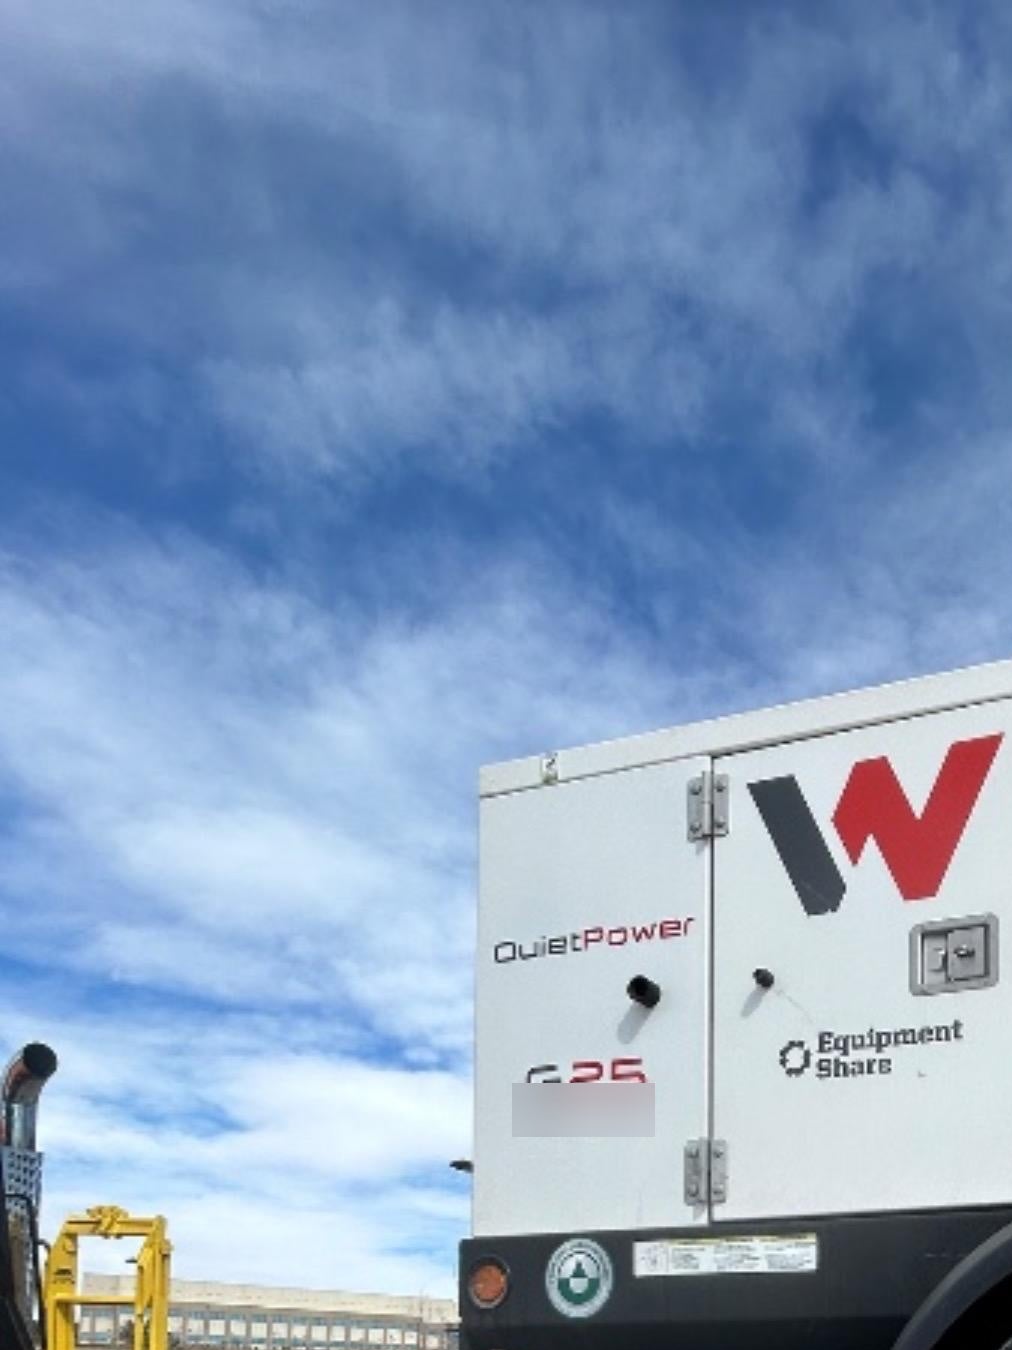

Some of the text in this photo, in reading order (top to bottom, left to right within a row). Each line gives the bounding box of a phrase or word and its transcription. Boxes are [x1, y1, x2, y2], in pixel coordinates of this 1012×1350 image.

[494, 917, 694, 963] QuietPower
[817, 1019, 964, 1056] Equipment
[815, 1057, 892, 1079] Share
